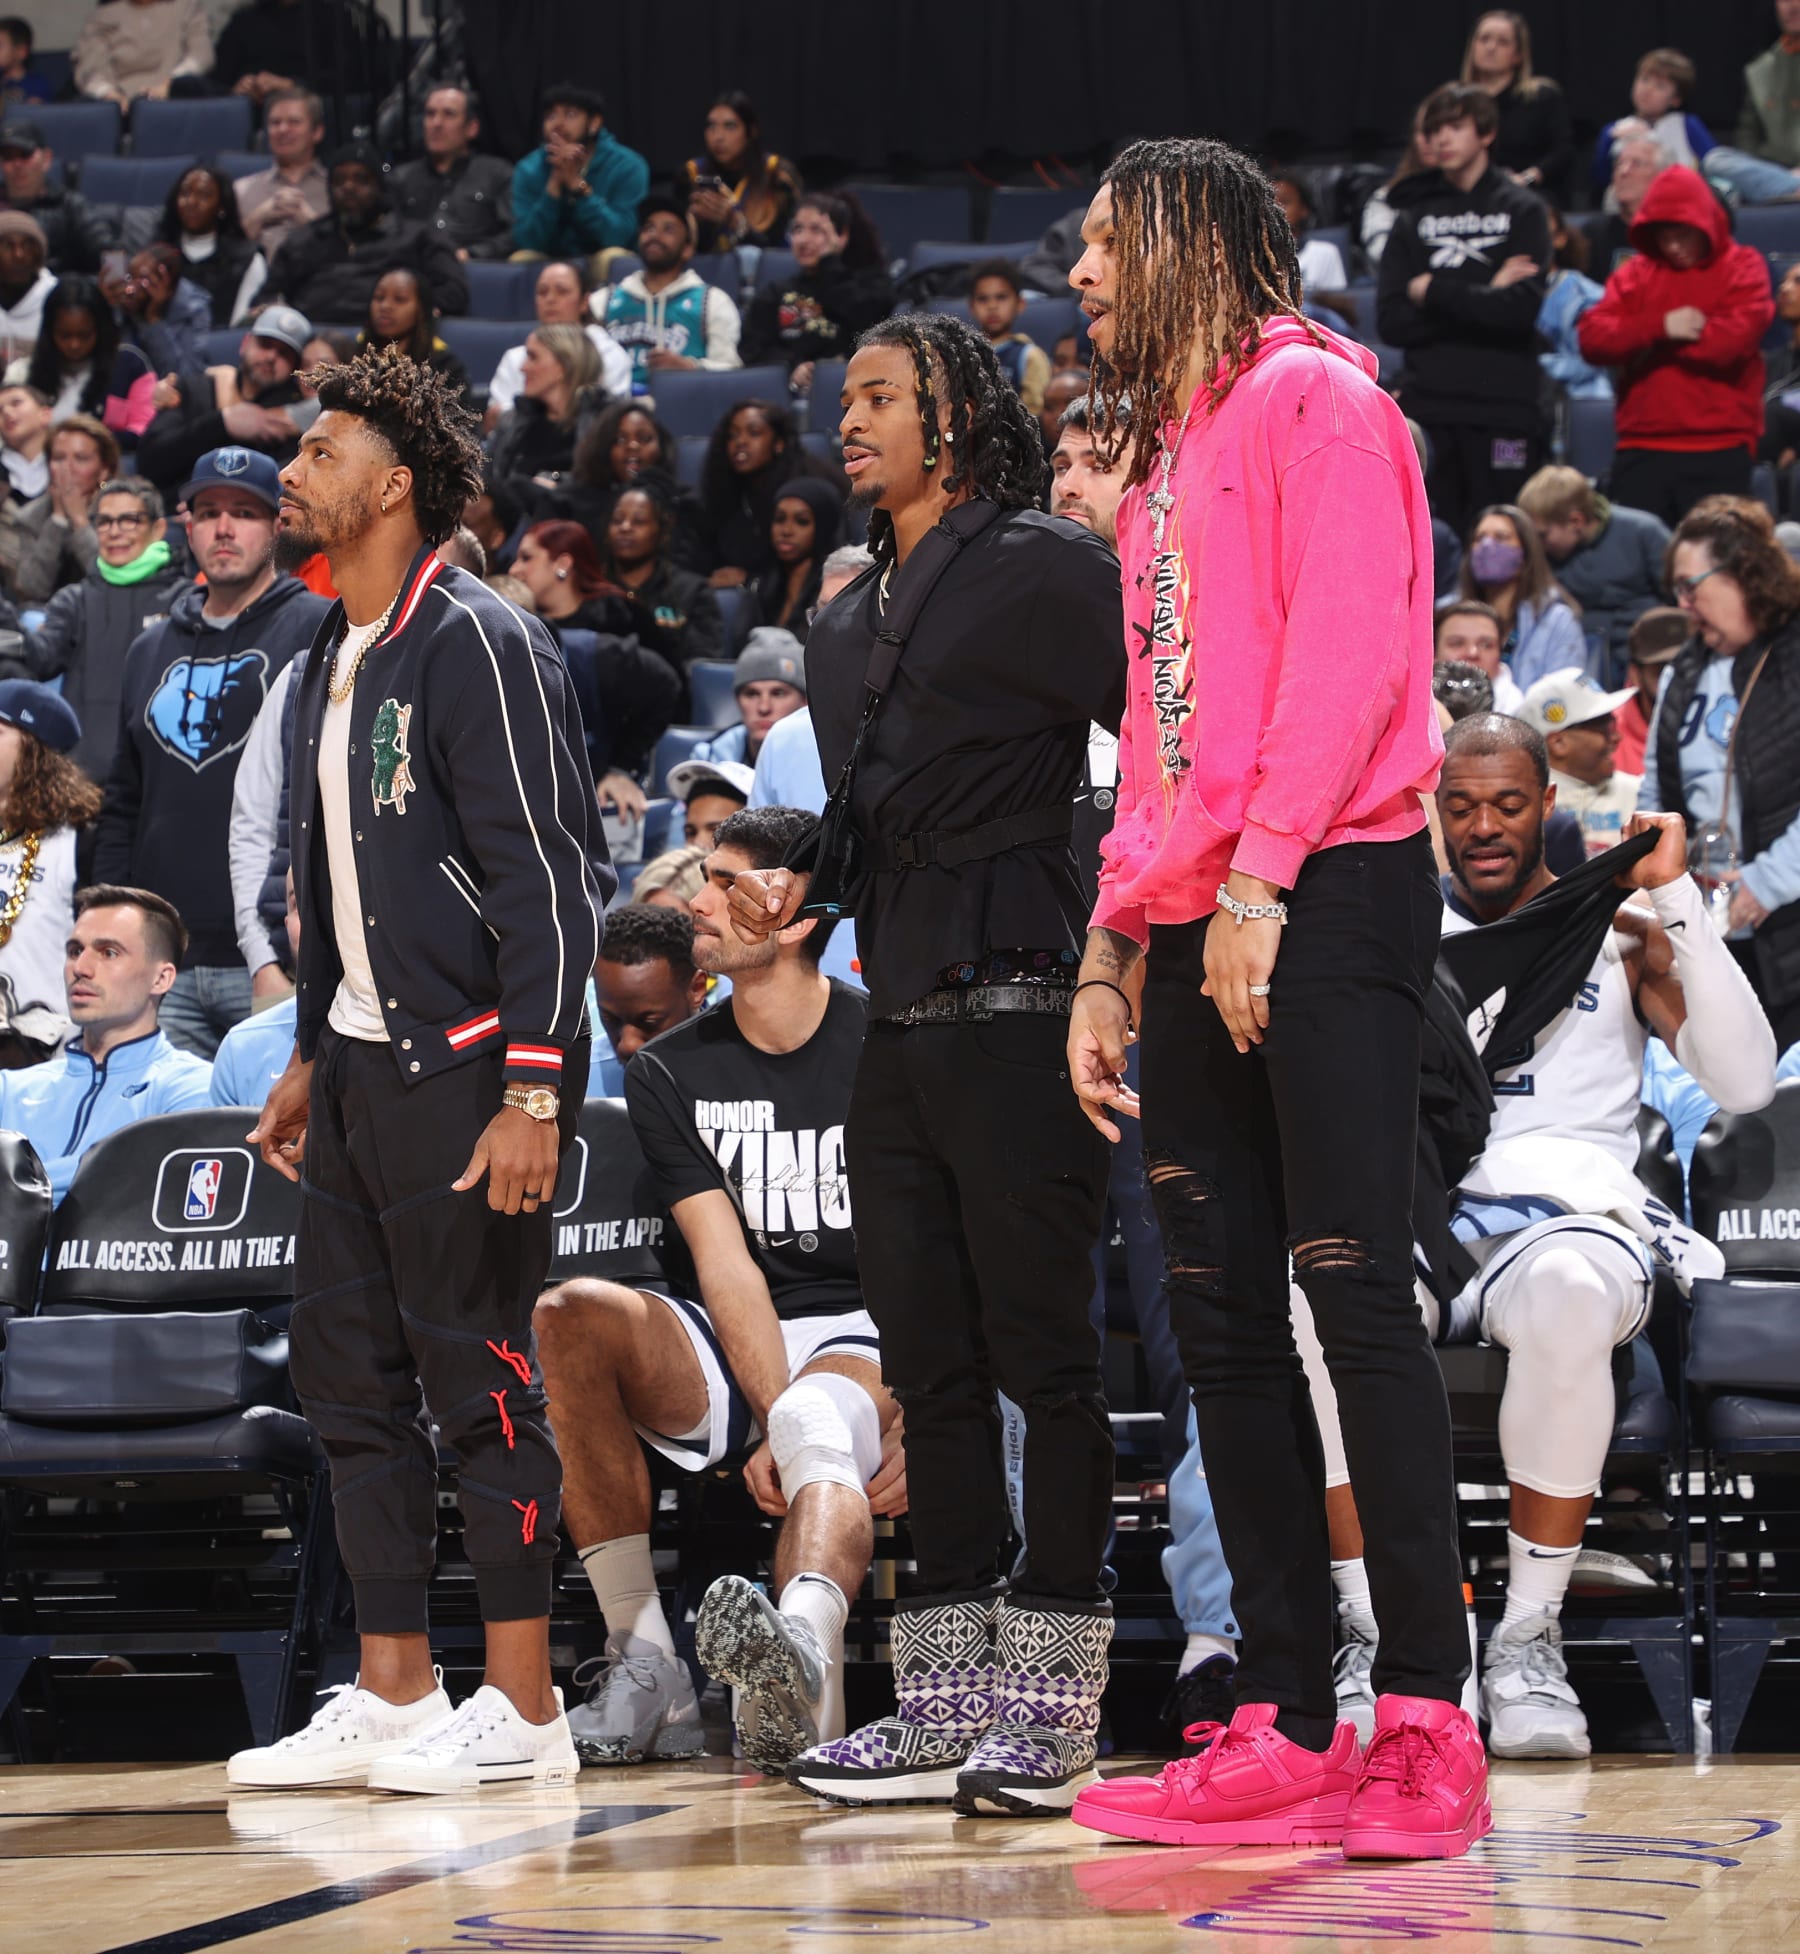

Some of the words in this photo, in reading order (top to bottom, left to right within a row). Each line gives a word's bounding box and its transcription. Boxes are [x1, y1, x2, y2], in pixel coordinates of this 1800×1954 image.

[1418, 211, 1511, 238] Reebok
[695, 1099, 775, 1131] HONOR
[558, 1224, 580, 1256] IN
[583, 1220, 622, 1253] THE
[623, 1217, 664, 1248] APP.
[1717, 1211, 1757, 1243] ALL
[56, 1239, 91, 1271] ALL
[94, 1240, 176, 1272] ACCESS.
[179, 1240, 215, 1271] ALL
[219, 1239, 242, 1270] IN
[246, 1236, 283, 1268] THE
